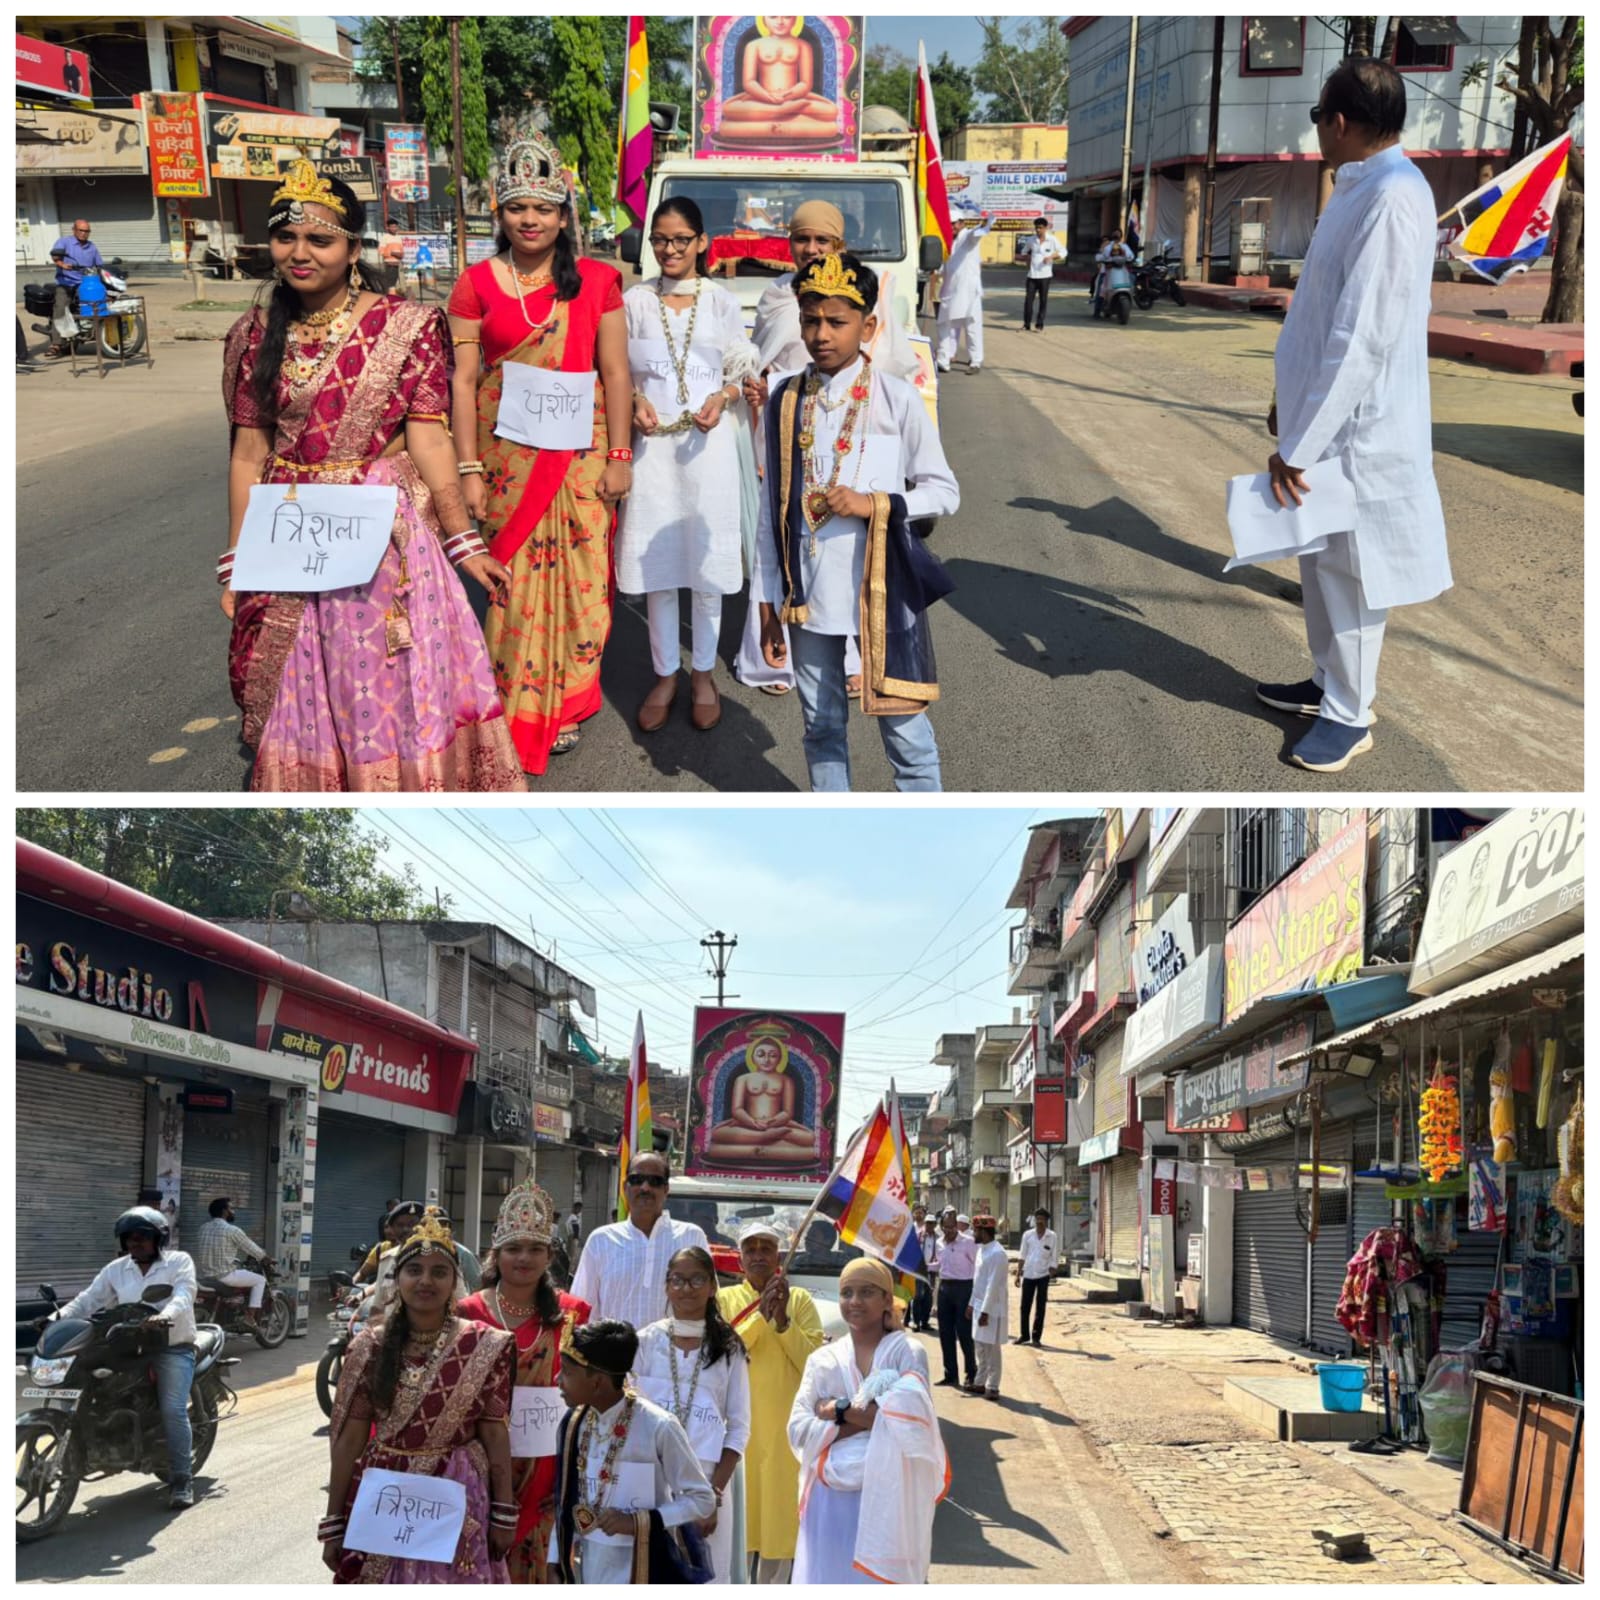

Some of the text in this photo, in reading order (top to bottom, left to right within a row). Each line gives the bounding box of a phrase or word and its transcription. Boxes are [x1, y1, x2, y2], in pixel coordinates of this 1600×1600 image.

[57, 128, 95, 144] POP
[986, 174, 1021, 185] SMILE
[523, 382, 584, 424] यशोदा
[271, 502, 376, 547] त्रिशला
[50, 941, 173, 1021] Studio
[130, 1017, 232, 1064] Xtreme Studio
[325, 1050, 343, 1082] 10
[375, 1485, 450, 1521] त्रिशला
